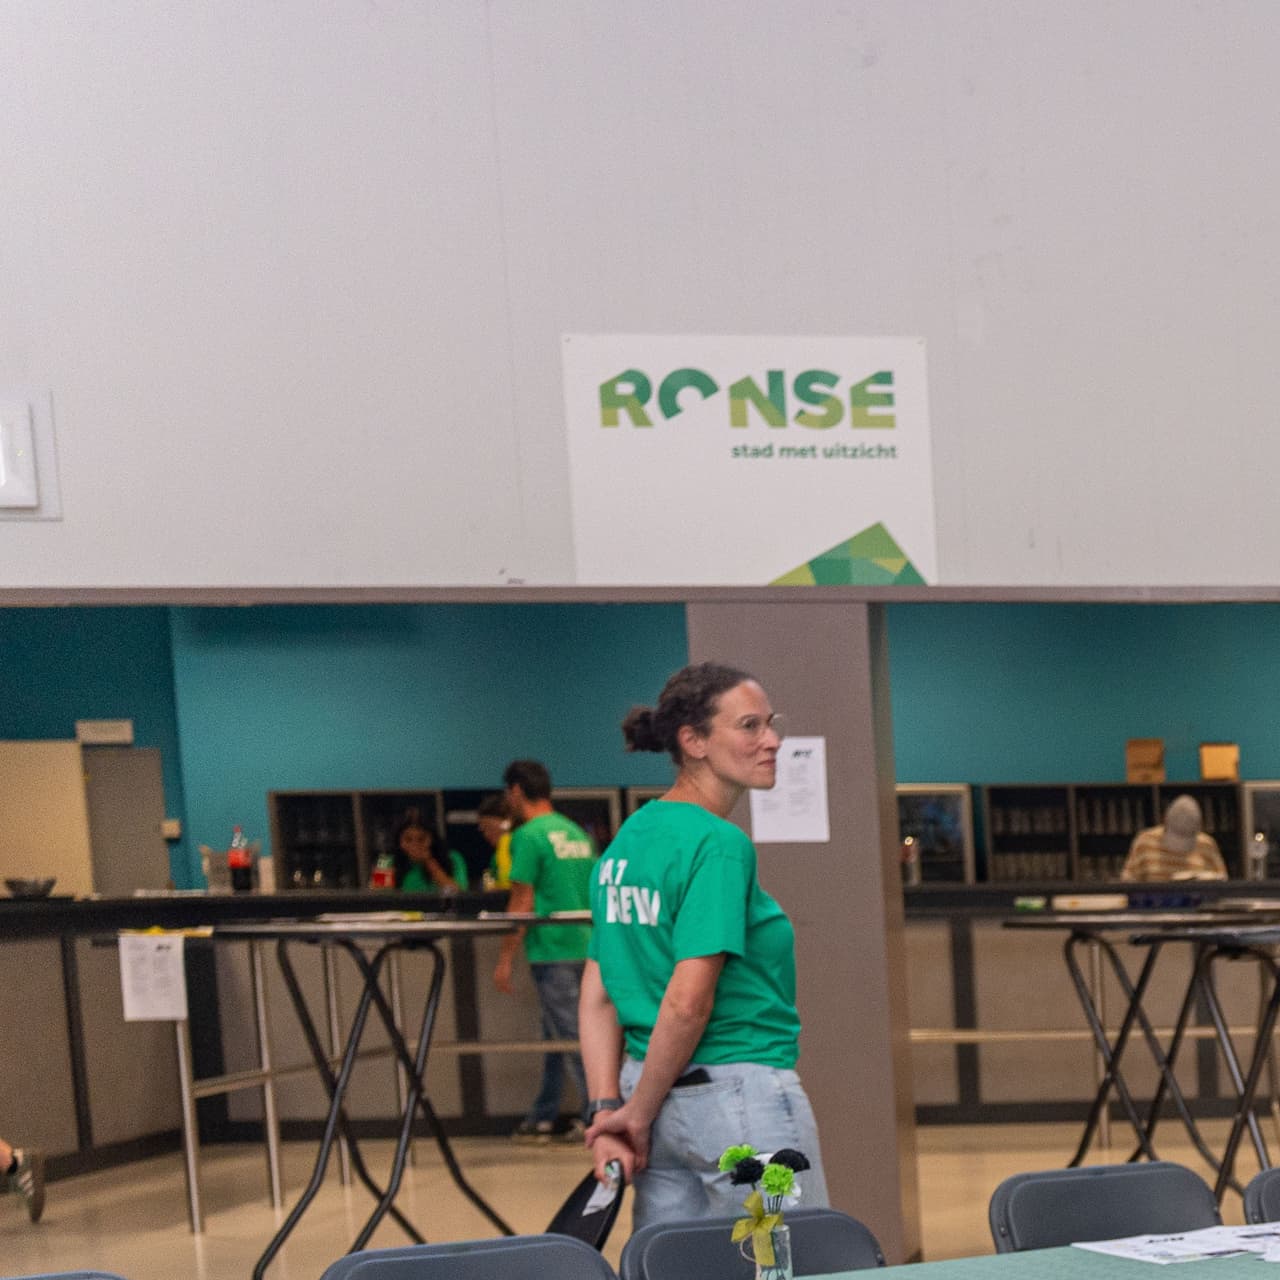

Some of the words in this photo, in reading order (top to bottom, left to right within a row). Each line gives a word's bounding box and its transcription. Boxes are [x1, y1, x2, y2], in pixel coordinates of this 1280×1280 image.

[598, 367, 897, 430] RONSE
[731, 442, 774, 459] stad
[779, 443, 817, 459] met
[823, 442, 898, 459] uitzicht
[604, 885, 661, 928] REW
